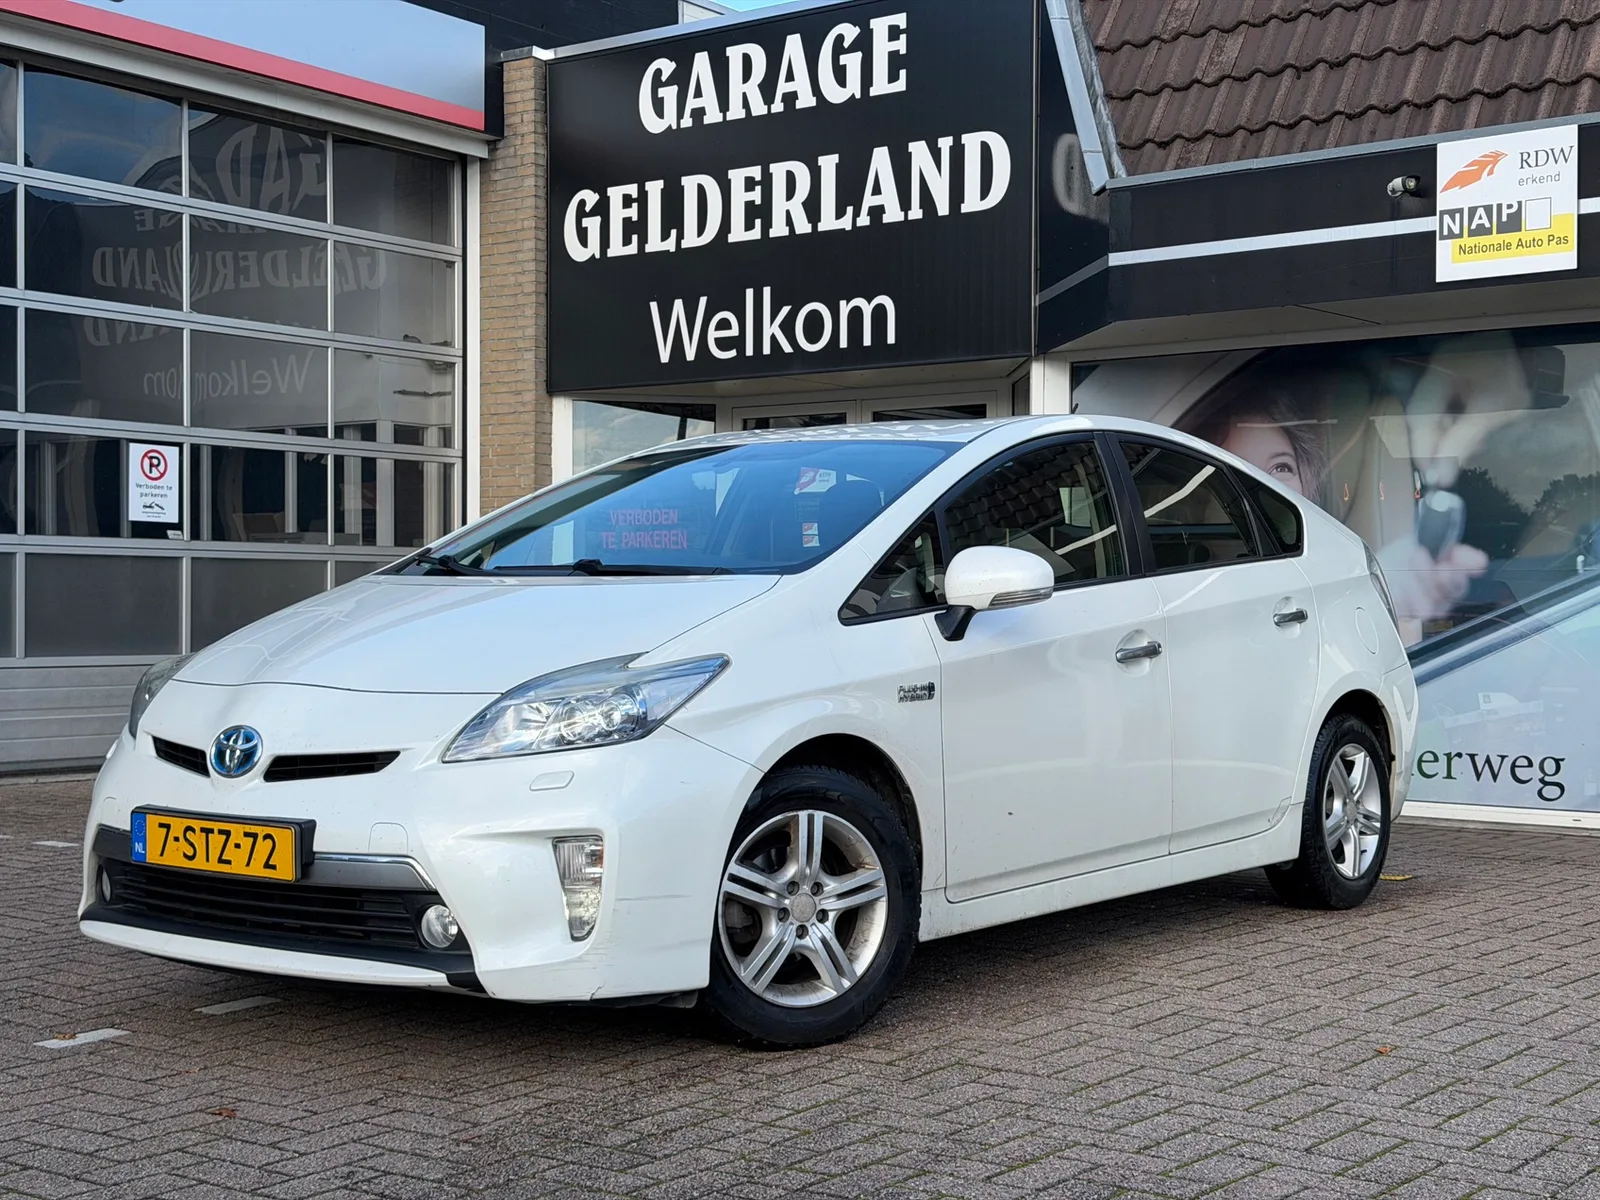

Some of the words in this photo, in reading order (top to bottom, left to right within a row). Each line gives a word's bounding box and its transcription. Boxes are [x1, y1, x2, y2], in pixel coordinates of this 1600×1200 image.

[638, 12, 908, 134] GARAGE
[1518, 145, 1575, 170] RDW
[1518, 171, 1561, 187] erkend
[563, 130, 1012, 263] GELDERLAND
[1458, 239, 1513, 256] Nationale
[1515, 236, 1544, 250] Auto
[1547, 234, 1569, 247] Pas
[649, 286, 897, 364] Welkom
[135, 482, 165, 491] Verboden
[140, 491, 168, 499] parkeren
[609, 508, 678, 526] VERBODEN
[601, 531, 617, 549] TE
[622, 529, 689, 550] PARKEREN
[1411, 750, 1566, 802] erweg
[135, 841, 146, 853] NL
[157, 821, 278, 872] 7-STZ-72
